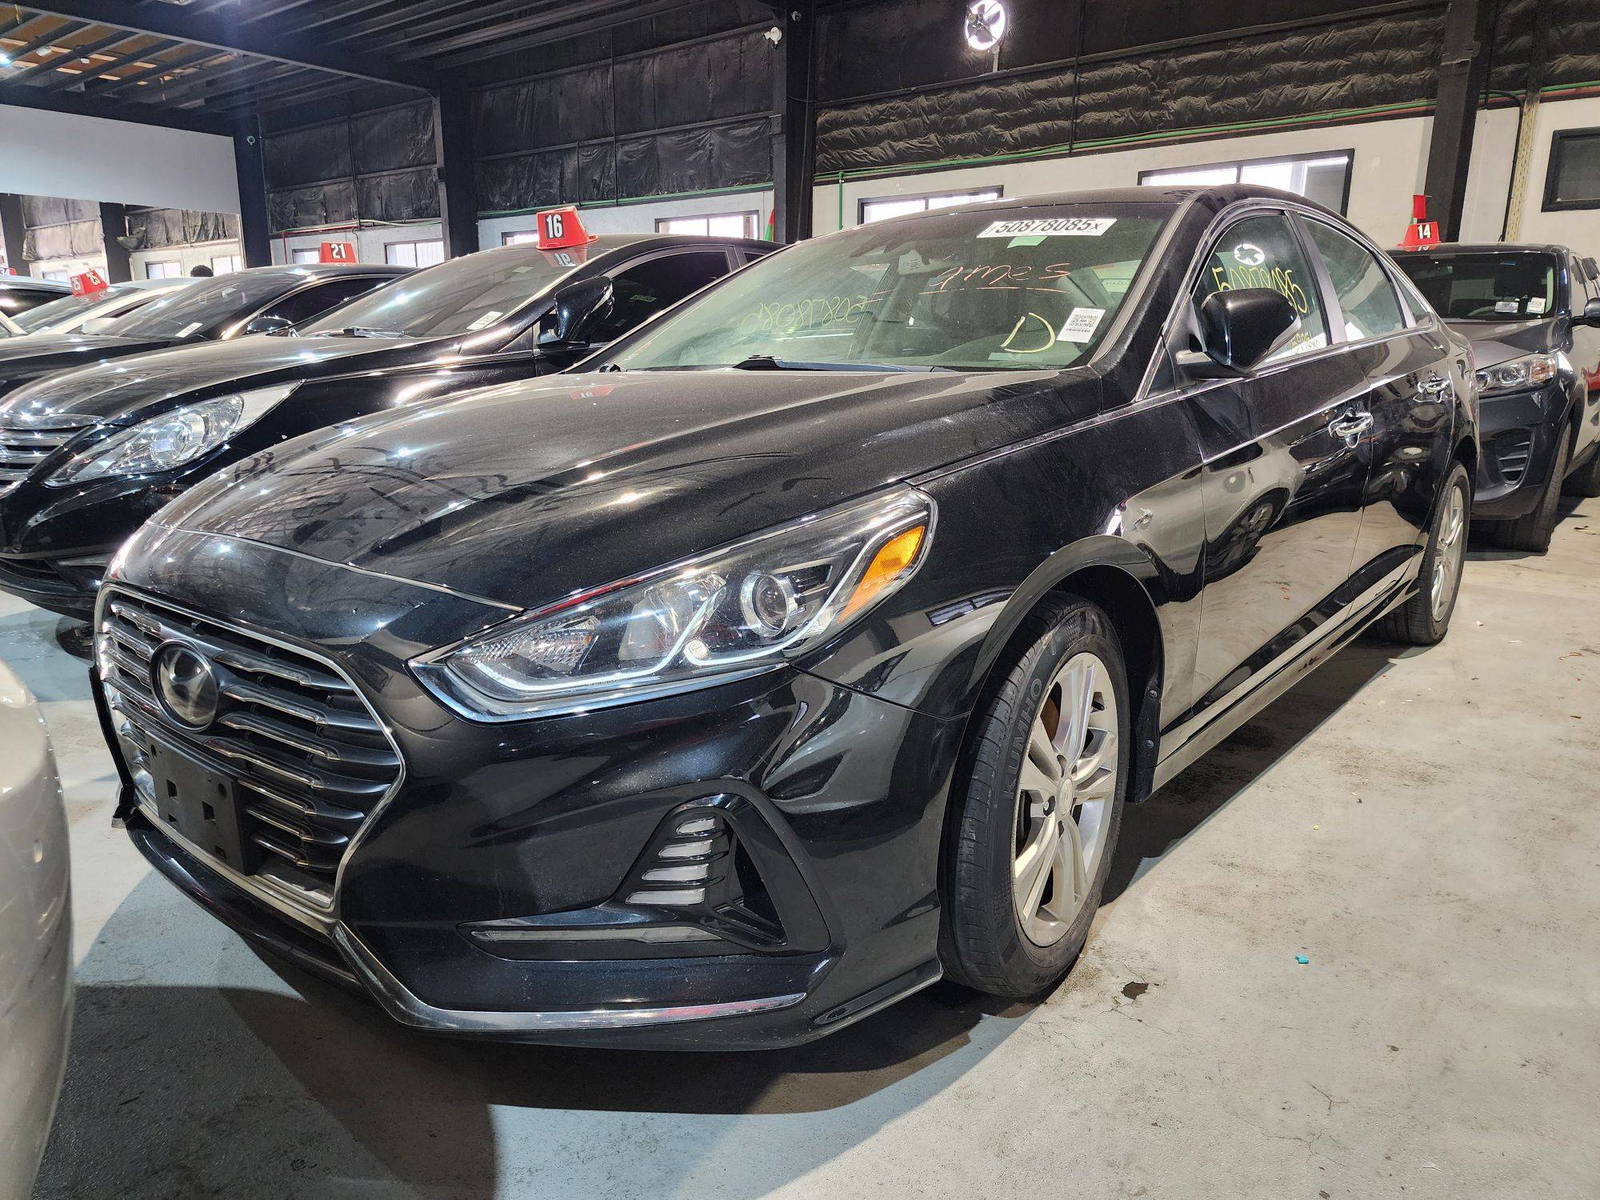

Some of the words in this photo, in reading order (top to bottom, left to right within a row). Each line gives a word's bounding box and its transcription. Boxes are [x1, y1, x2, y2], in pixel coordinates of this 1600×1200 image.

[546, 214, 563, 239] 16
[1417, 224, 1431, 240] 14
[331, 243, 347, 259] 21
[1000, 312, 1056, 353] D
[1003, 677, 1043, 796] KUMHO
